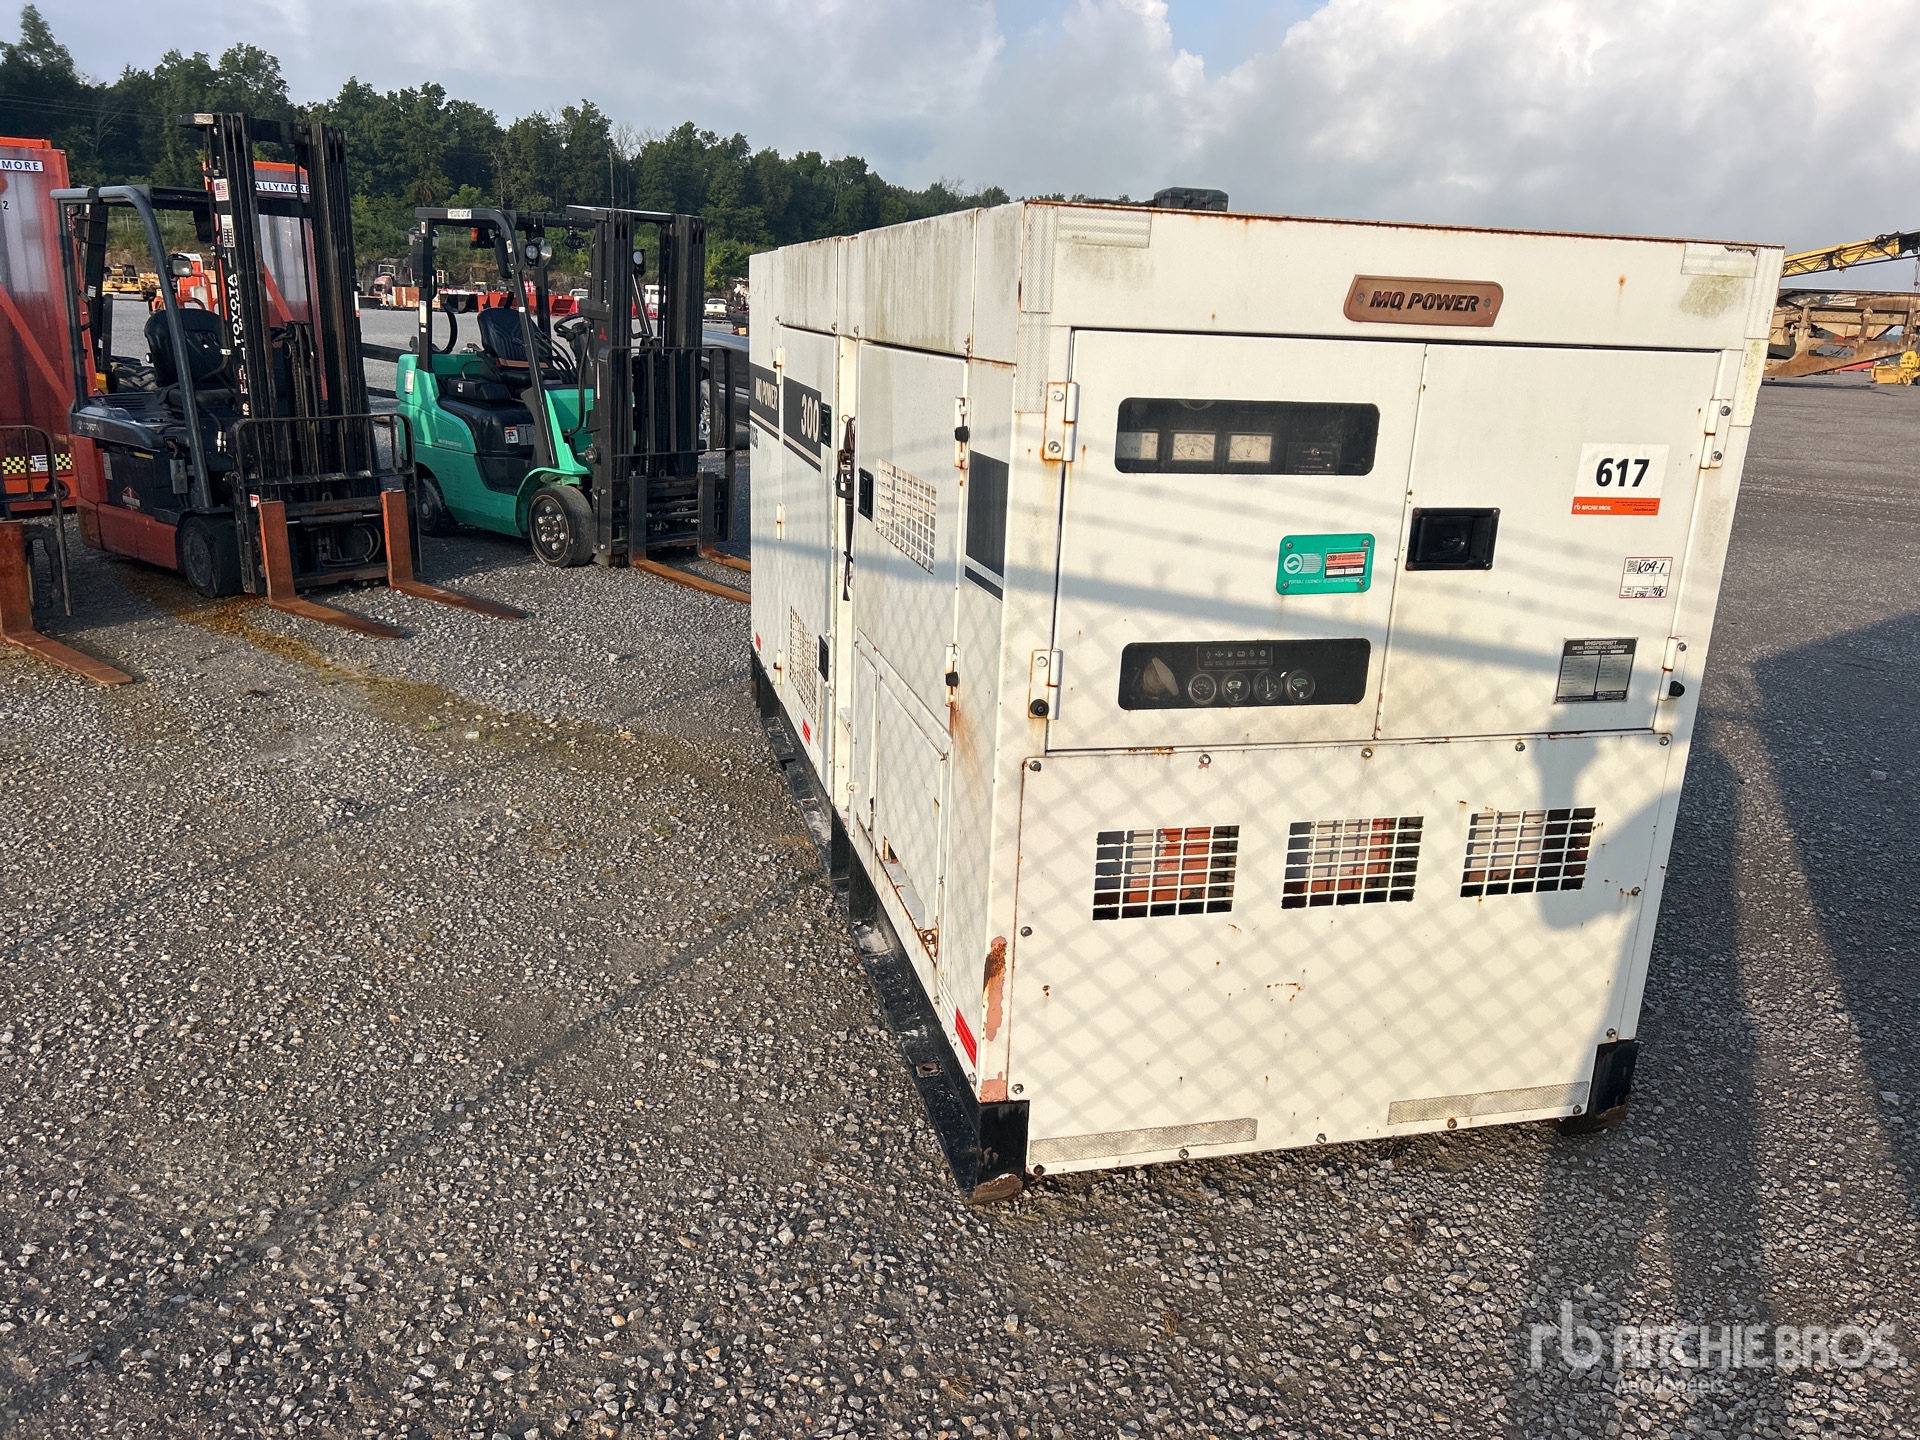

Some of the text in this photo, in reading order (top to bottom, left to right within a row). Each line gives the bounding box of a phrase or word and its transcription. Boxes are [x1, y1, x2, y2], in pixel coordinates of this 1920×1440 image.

[227, 272, 244, 347] TOYOTA
[1369, 290, 1480, 313] MQ POWER
[801, 393, 820, 443] 300
[1595, 457, 1650, 488] 617
